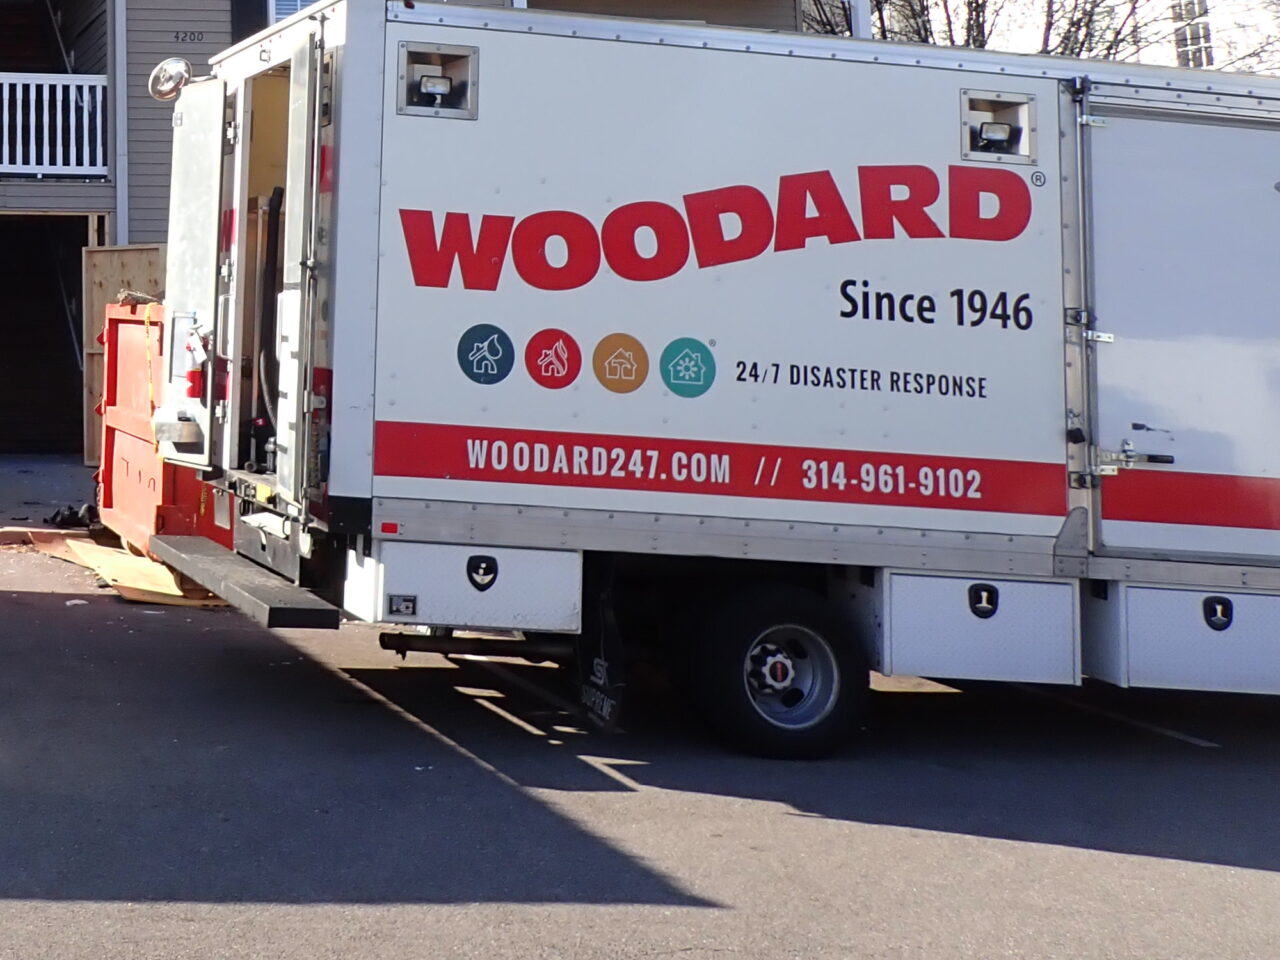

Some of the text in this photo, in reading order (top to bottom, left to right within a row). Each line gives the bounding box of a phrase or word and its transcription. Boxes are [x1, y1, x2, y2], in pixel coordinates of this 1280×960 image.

[173, 31, 204, 42] 4200
[399, 165, 1032, 291] WOODARD
[839, 279, 1033, 331] Since 1946
[735, 361, 987, 399] 24/7 DISASTER RESPONSE
[467, 439, 731, 484] WOODARD247.COM
[802, 459, 982, 499] 314-961-9102
